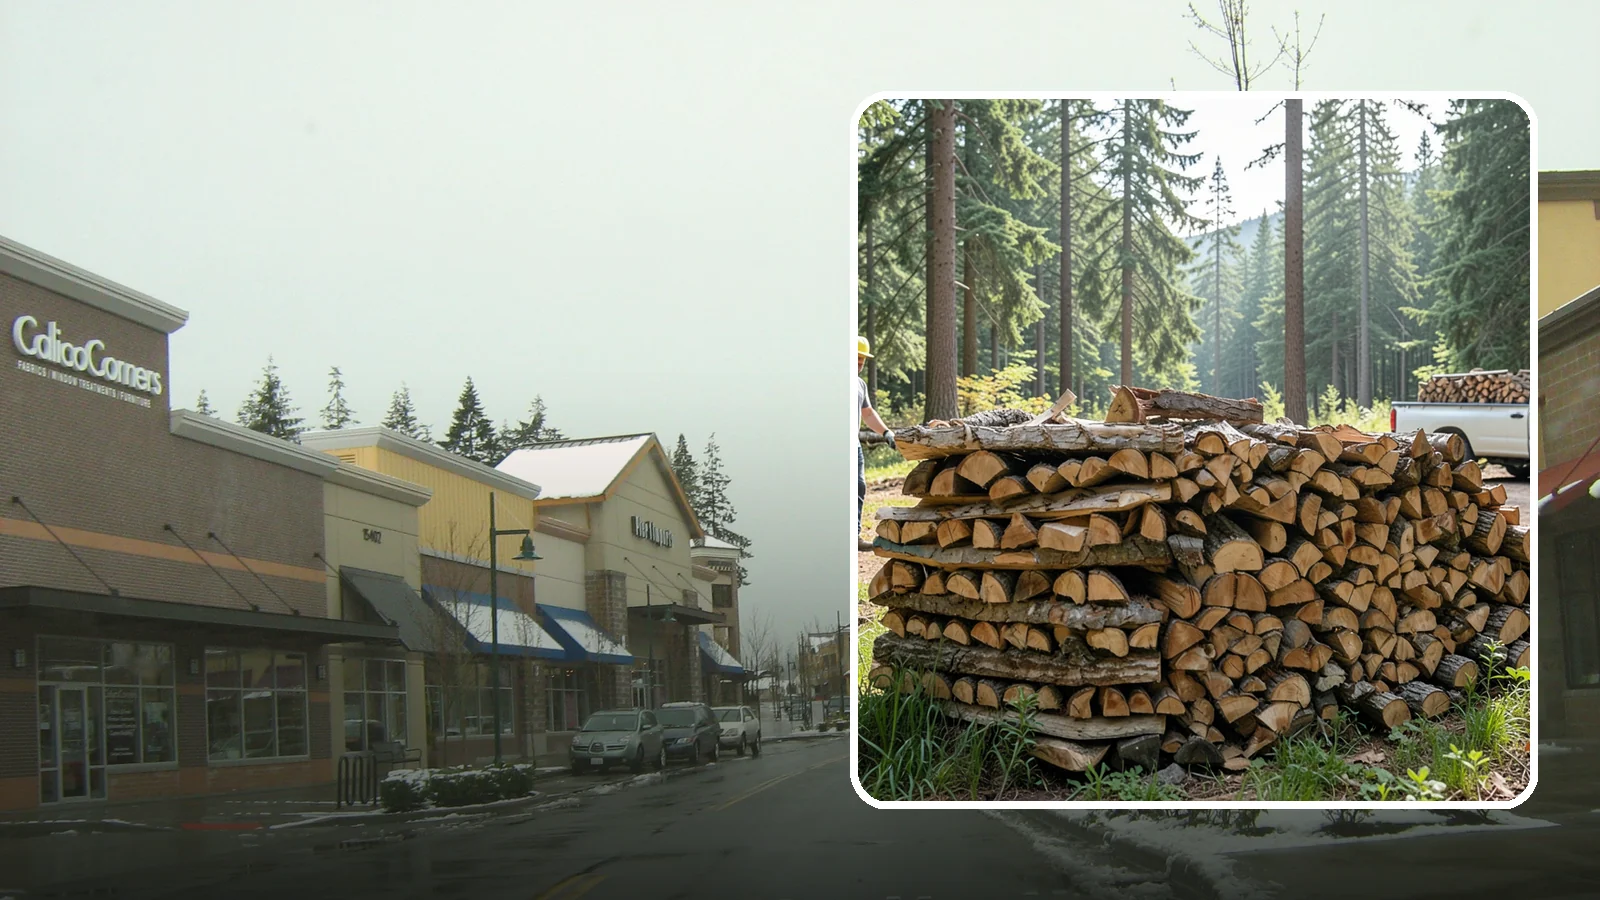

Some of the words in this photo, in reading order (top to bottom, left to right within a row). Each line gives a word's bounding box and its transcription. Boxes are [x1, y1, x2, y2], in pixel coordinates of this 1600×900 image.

[17, 360, 47, 377] FABRICS
[51, 371, 78, 388] WINDOW
[79, 378, 117, 398] TREATMENTS
[120, 391, 151, 409] FURNITURE
